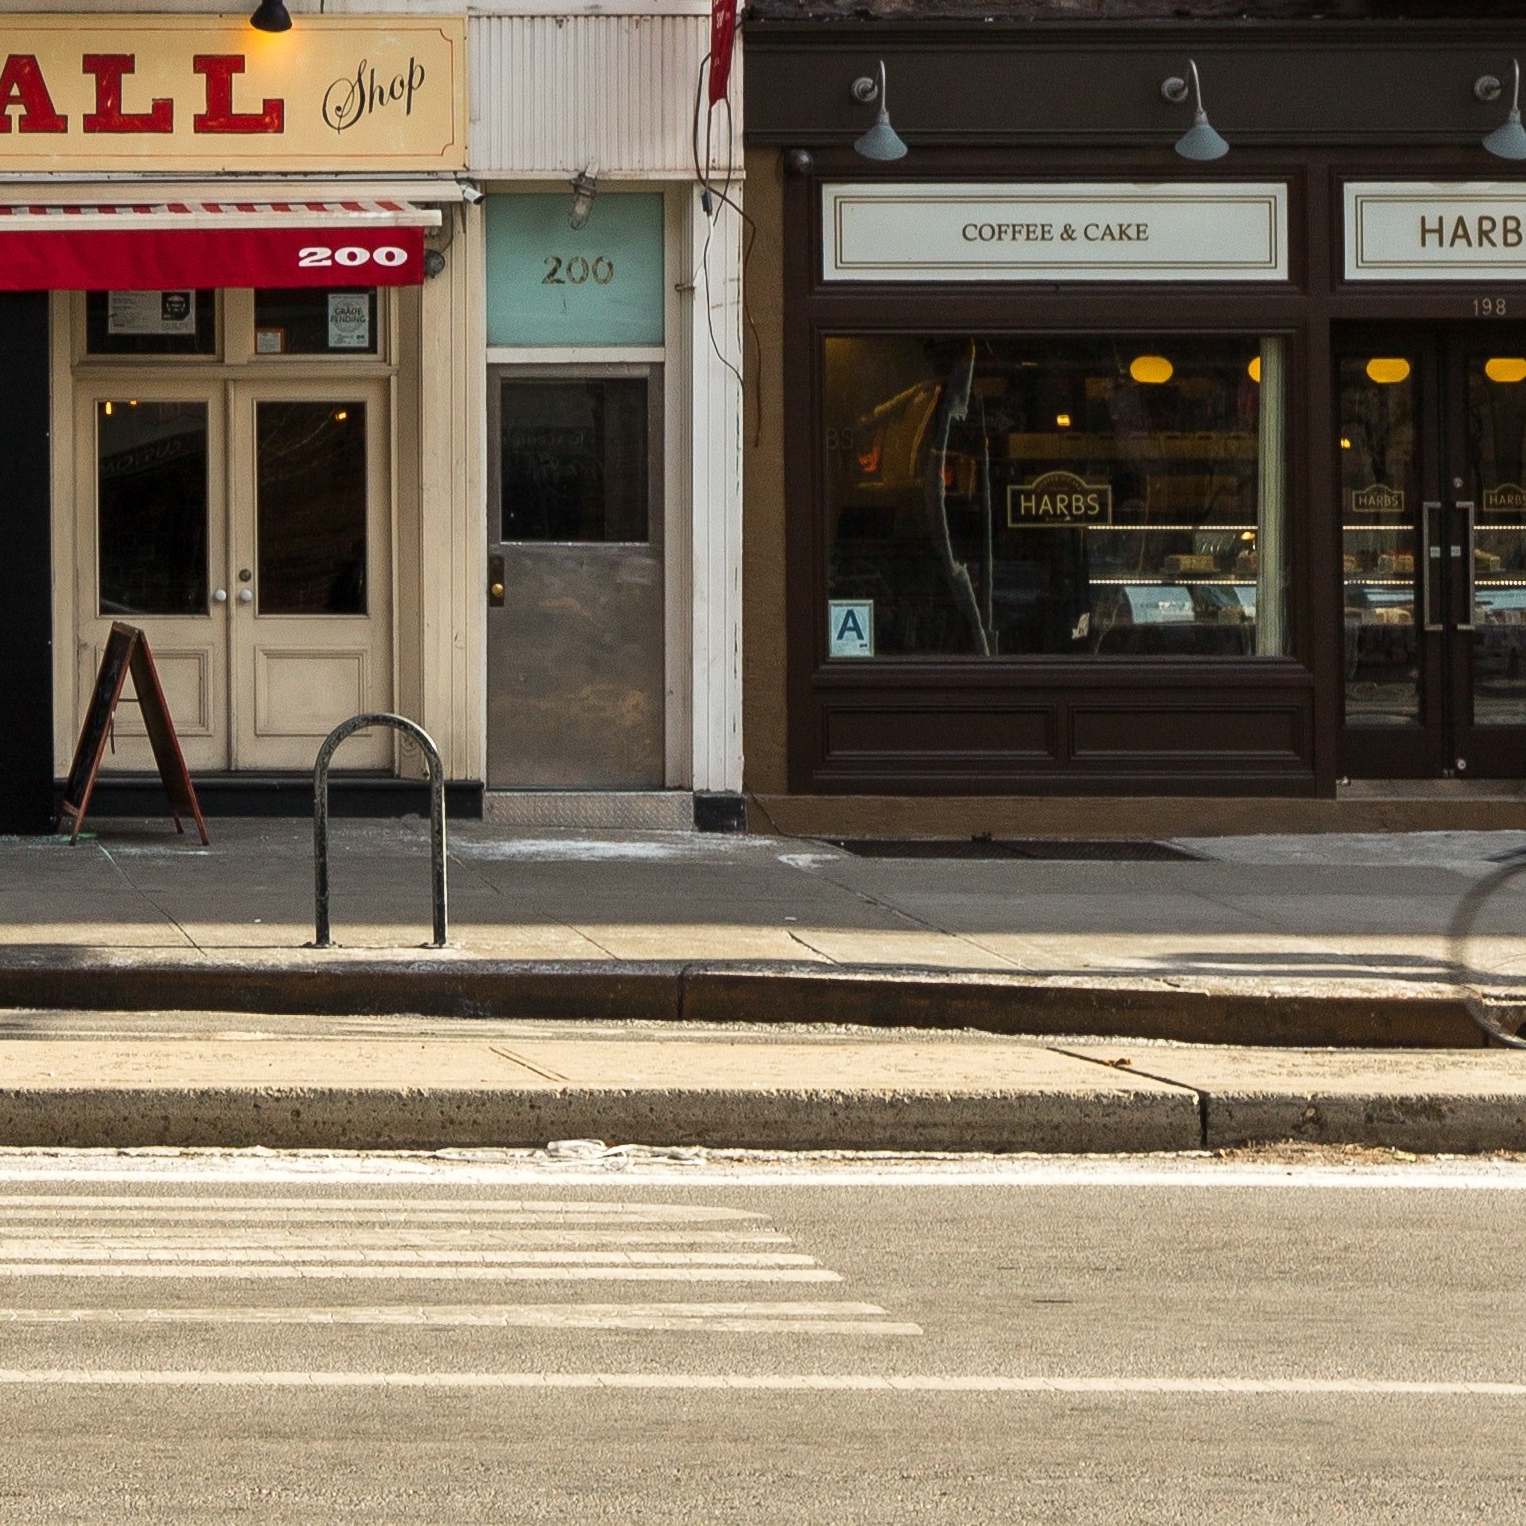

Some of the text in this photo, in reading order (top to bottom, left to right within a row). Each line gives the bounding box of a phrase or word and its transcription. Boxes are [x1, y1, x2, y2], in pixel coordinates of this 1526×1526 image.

[322, 56, 426, 135] Shop
[962, 223, 1150, 242] COFFEE & CAKE
[1420, 215, 1523, 248] HARB
[298, 247, 408, 268] 200
[541, 256, 614, 284] 200
[1473, 297, 1506, 317] 198
[1021, 493, 1099, 515] HARBS
[1358, 494, 1399, 508] HARBS
[836, 609, 865, 641] A
